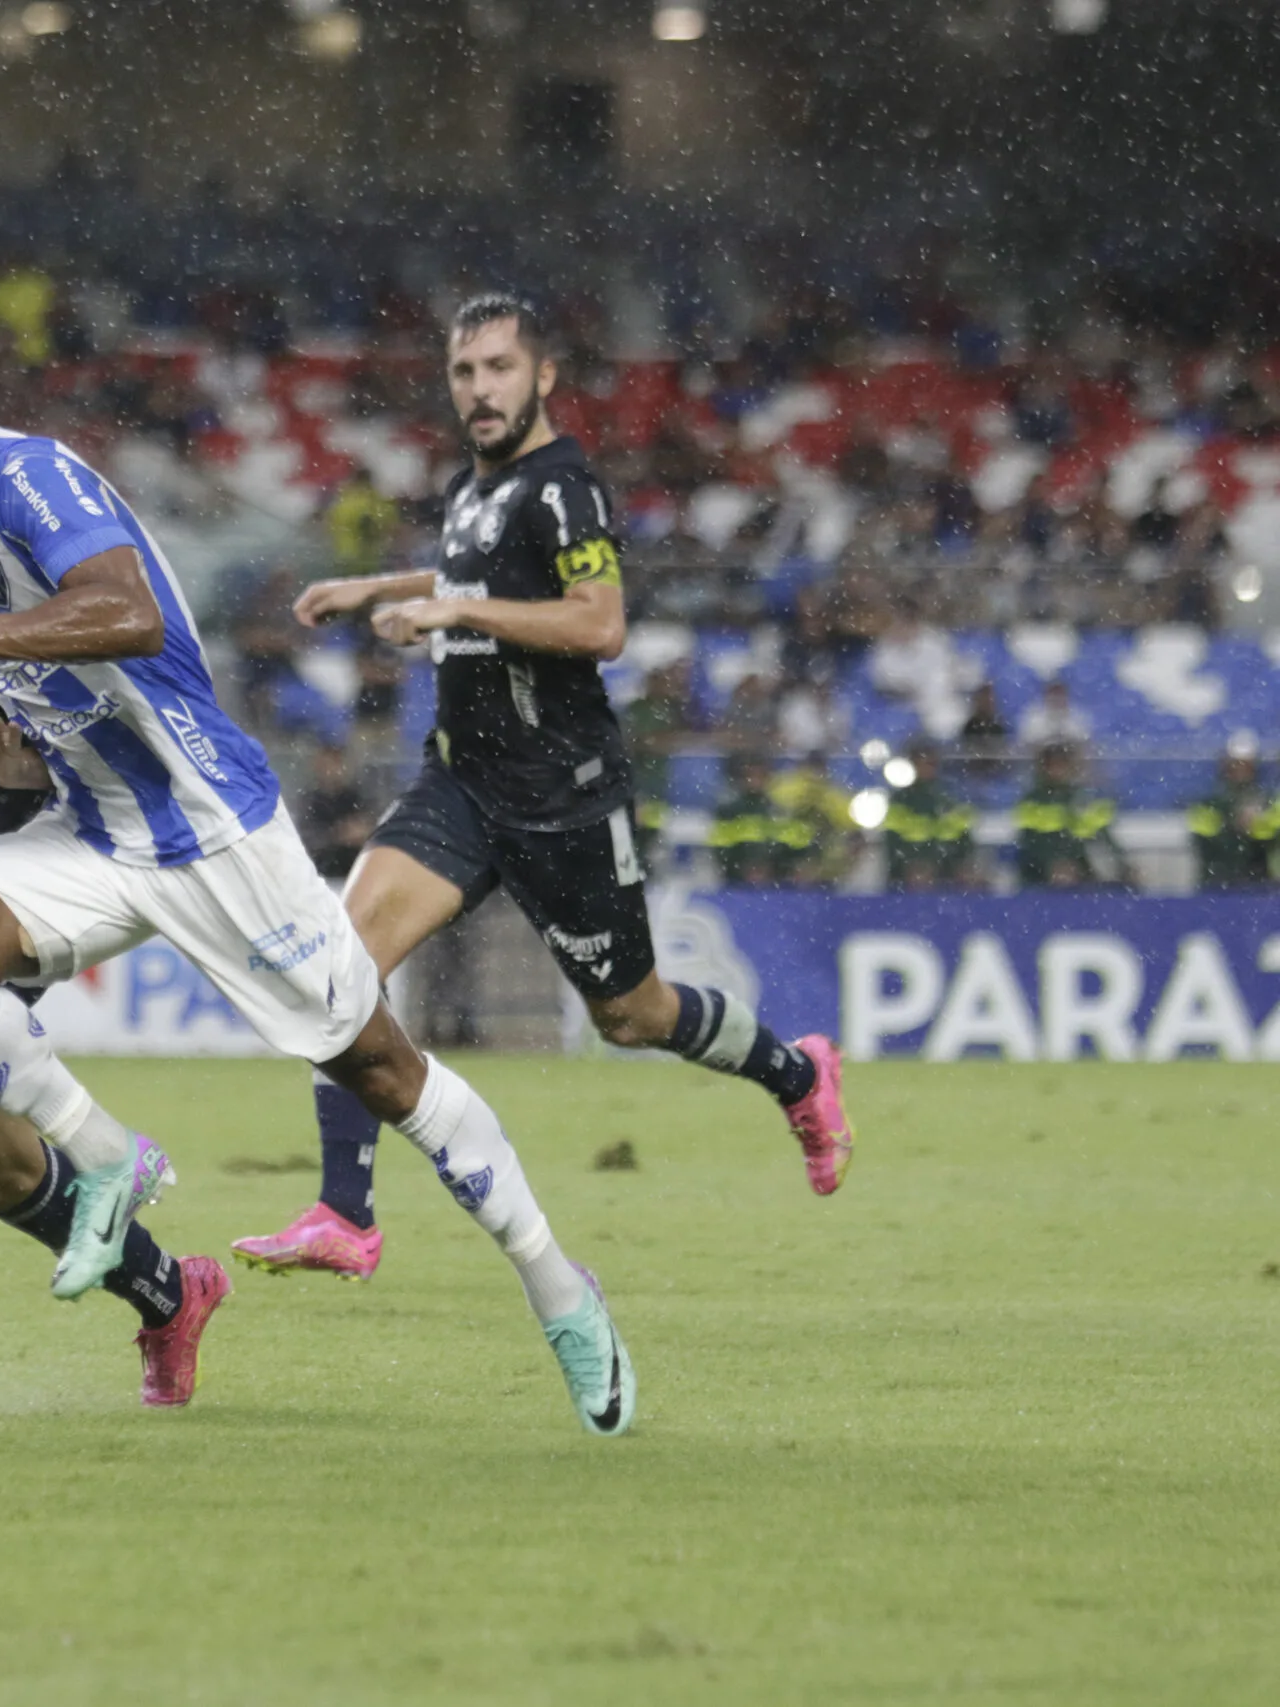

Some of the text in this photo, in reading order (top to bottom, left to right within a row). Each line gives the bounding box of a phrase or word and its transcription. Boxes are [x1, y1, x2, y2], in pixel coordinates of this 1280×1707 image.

[10, 470, 62, 533] Sankhya
[161, 695, 228, 783] Zilmar
[124, 935, 250, 1030] PA
